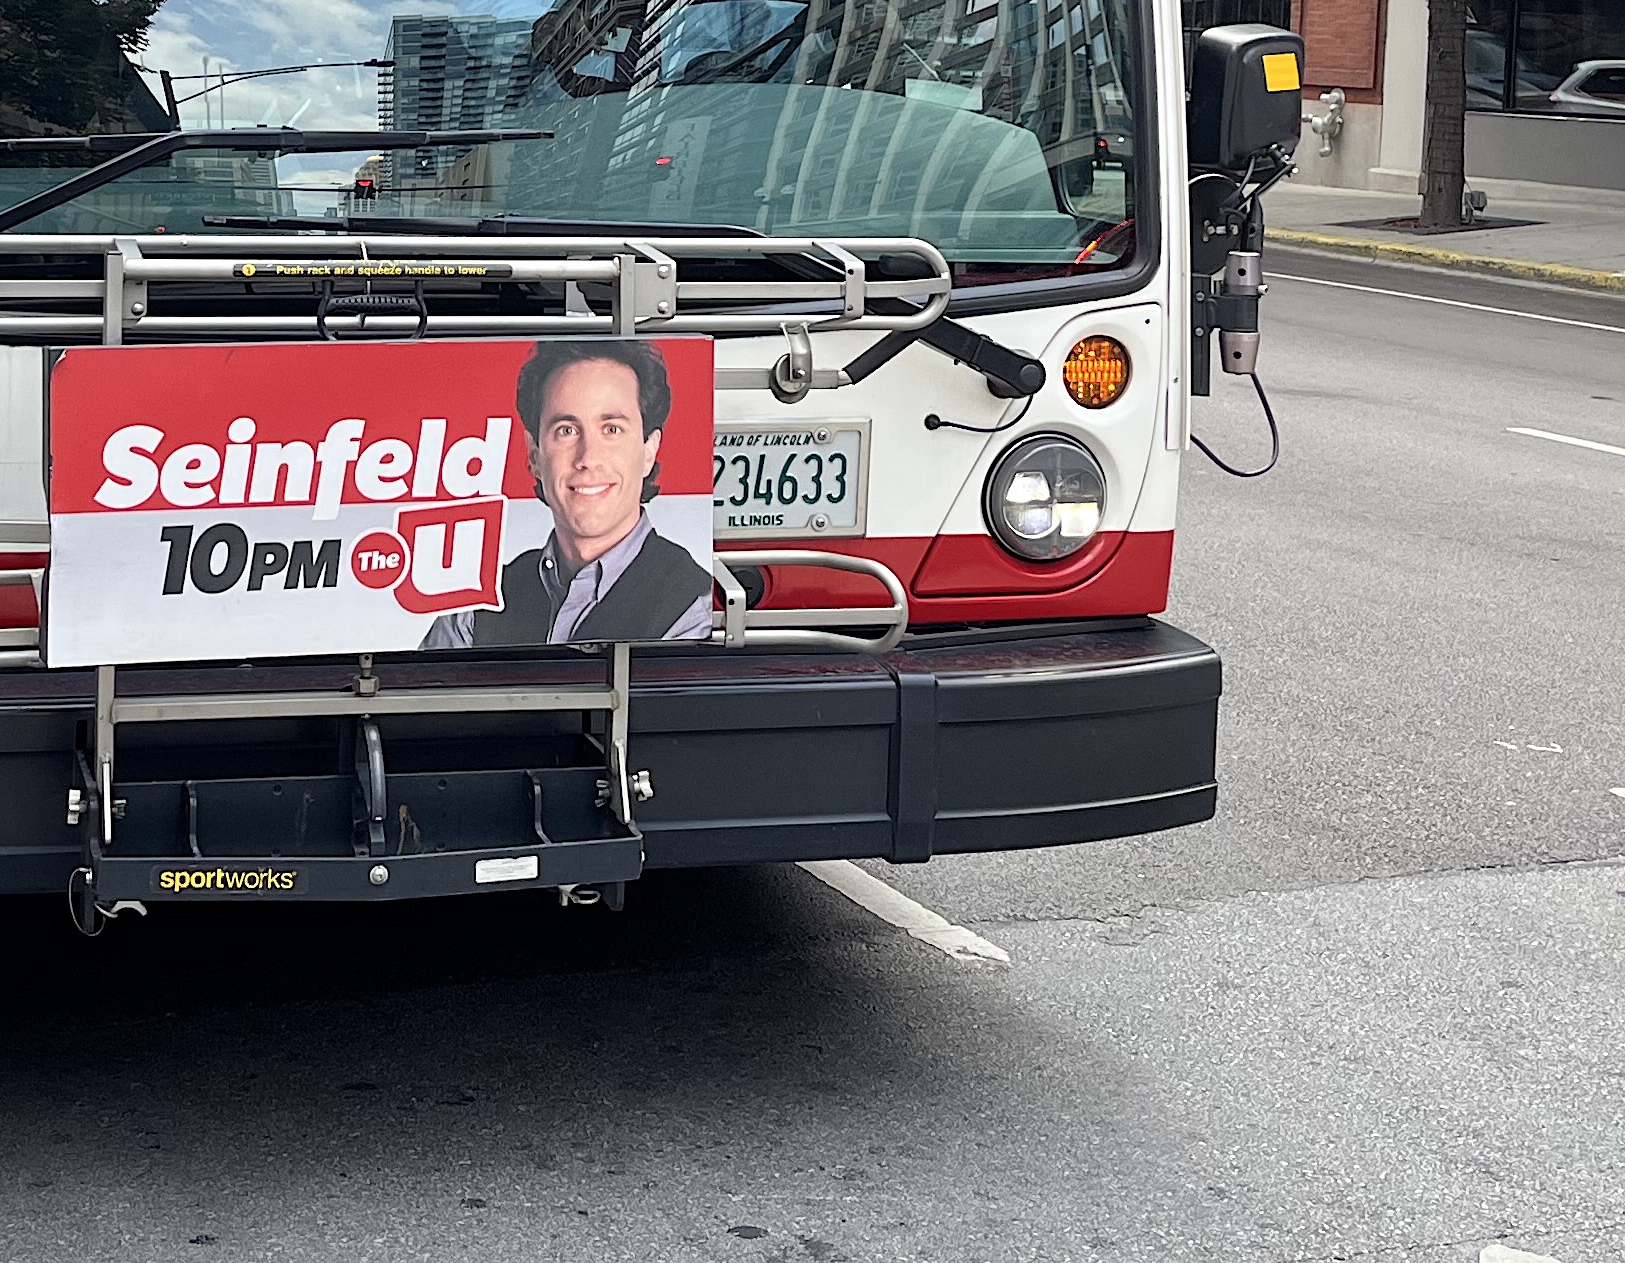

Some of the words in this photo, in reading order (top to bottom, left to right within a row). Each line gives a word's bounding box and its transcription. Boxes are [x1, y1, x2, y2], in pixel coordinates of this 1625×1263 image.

[276, 265, 304, 275] Push
[307, 265, 331, 275] rack
[334, 265, 355, 275] and
[357, 265, 402, 277] squeeze
[405, 265, 441, 275] handle
[444, 266, 456, 275] to
[458, 265, 488, 275] lower
[713, 435, 743, 447] LAND
[746, 434, 761, 446] OF
[763, 434, 812, 446] LINCOLN
[93, 417, 513, 521] Seinfeld
[713, 452, 847, 506] 234633
[728, 514, 784, 527] ILLINOIS
[357, 550, 401, 572] The
[160, 867, 295, 893] sportworks
